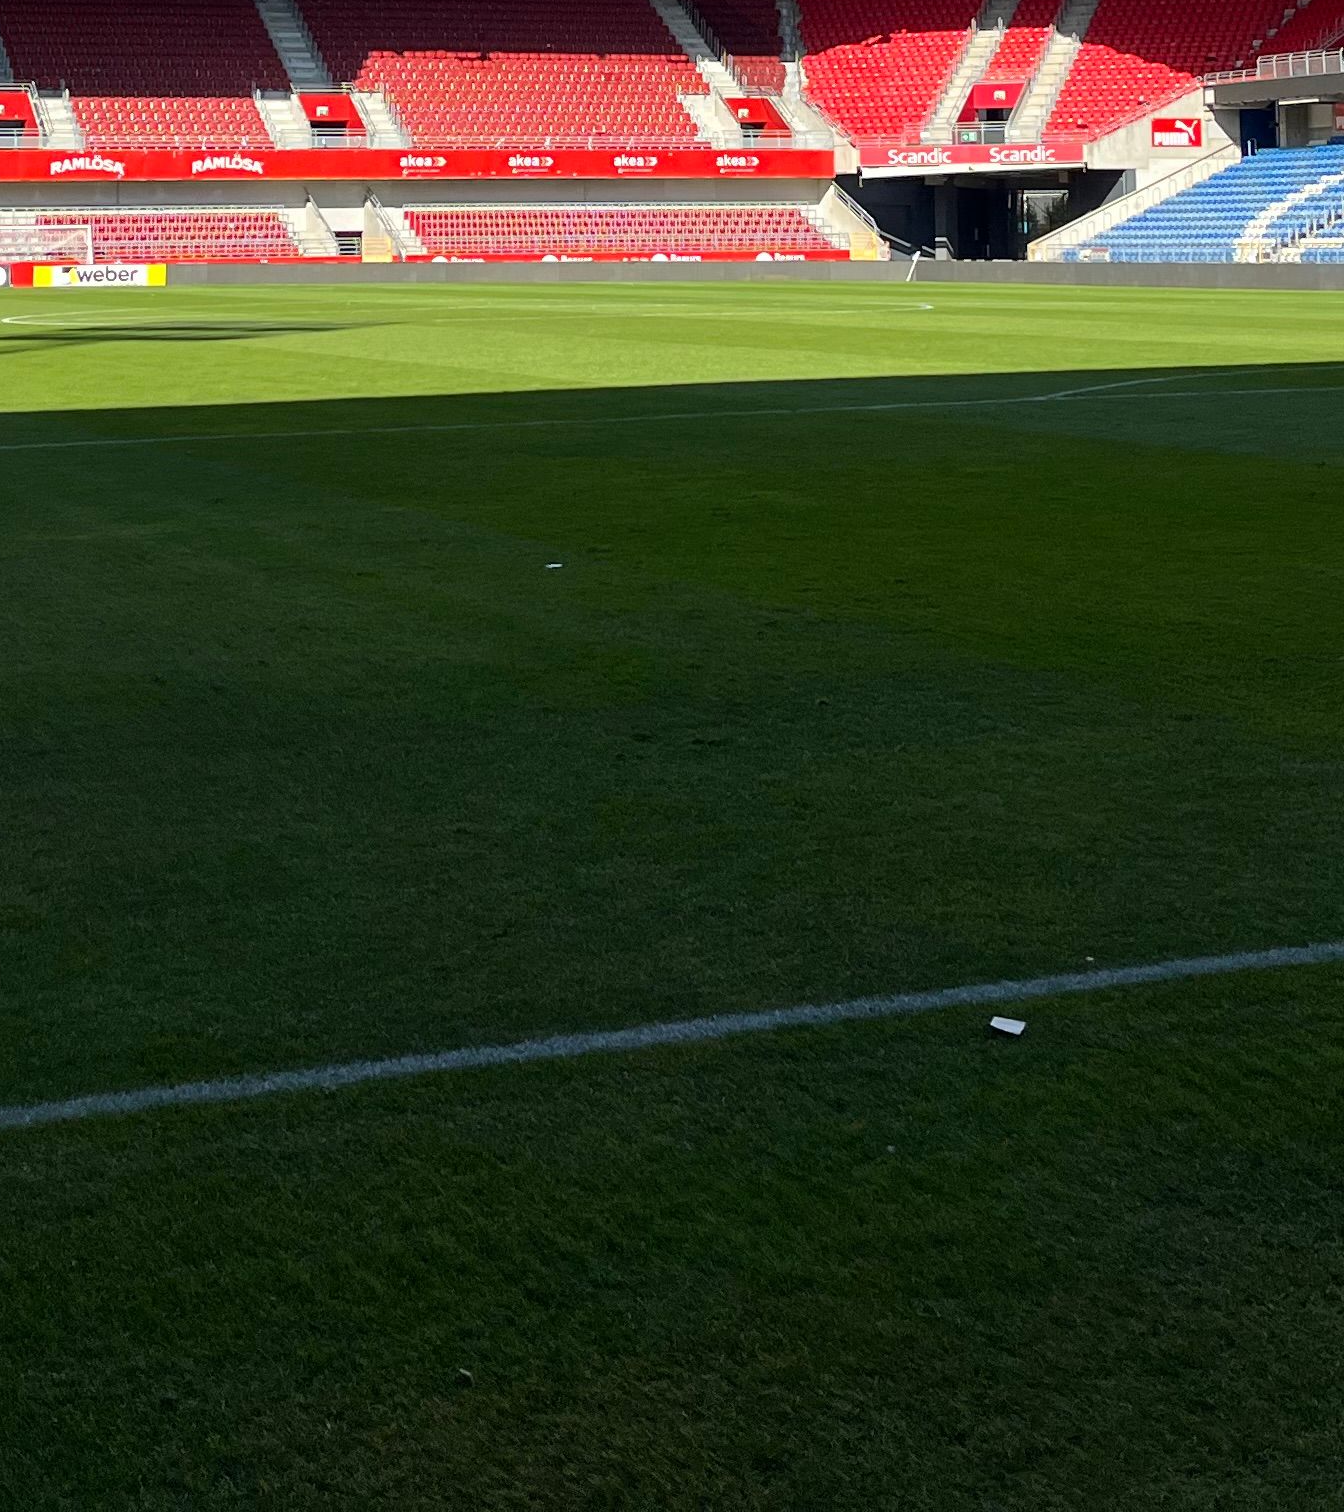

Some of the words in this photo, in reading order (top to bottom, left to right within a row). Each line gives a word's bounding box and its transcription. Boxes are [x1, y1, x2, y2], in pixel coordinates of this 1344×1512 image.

[1154, 131, 1190, 147] PUMA
[399, 154, 433, 167] akea
[507, 154, 540, 167] akea
[613, 154, 645, 167] akea
[716, 154, 747, 167] akea
[887, 147, 952, 164] Scandic
[989, 146, 1056, 162] Scandic
[50, 154, 125, 175] RAMLÖSA
[191, 153, 264, 174] RAMLÖSA
[76, 266, 139, 282] weber
